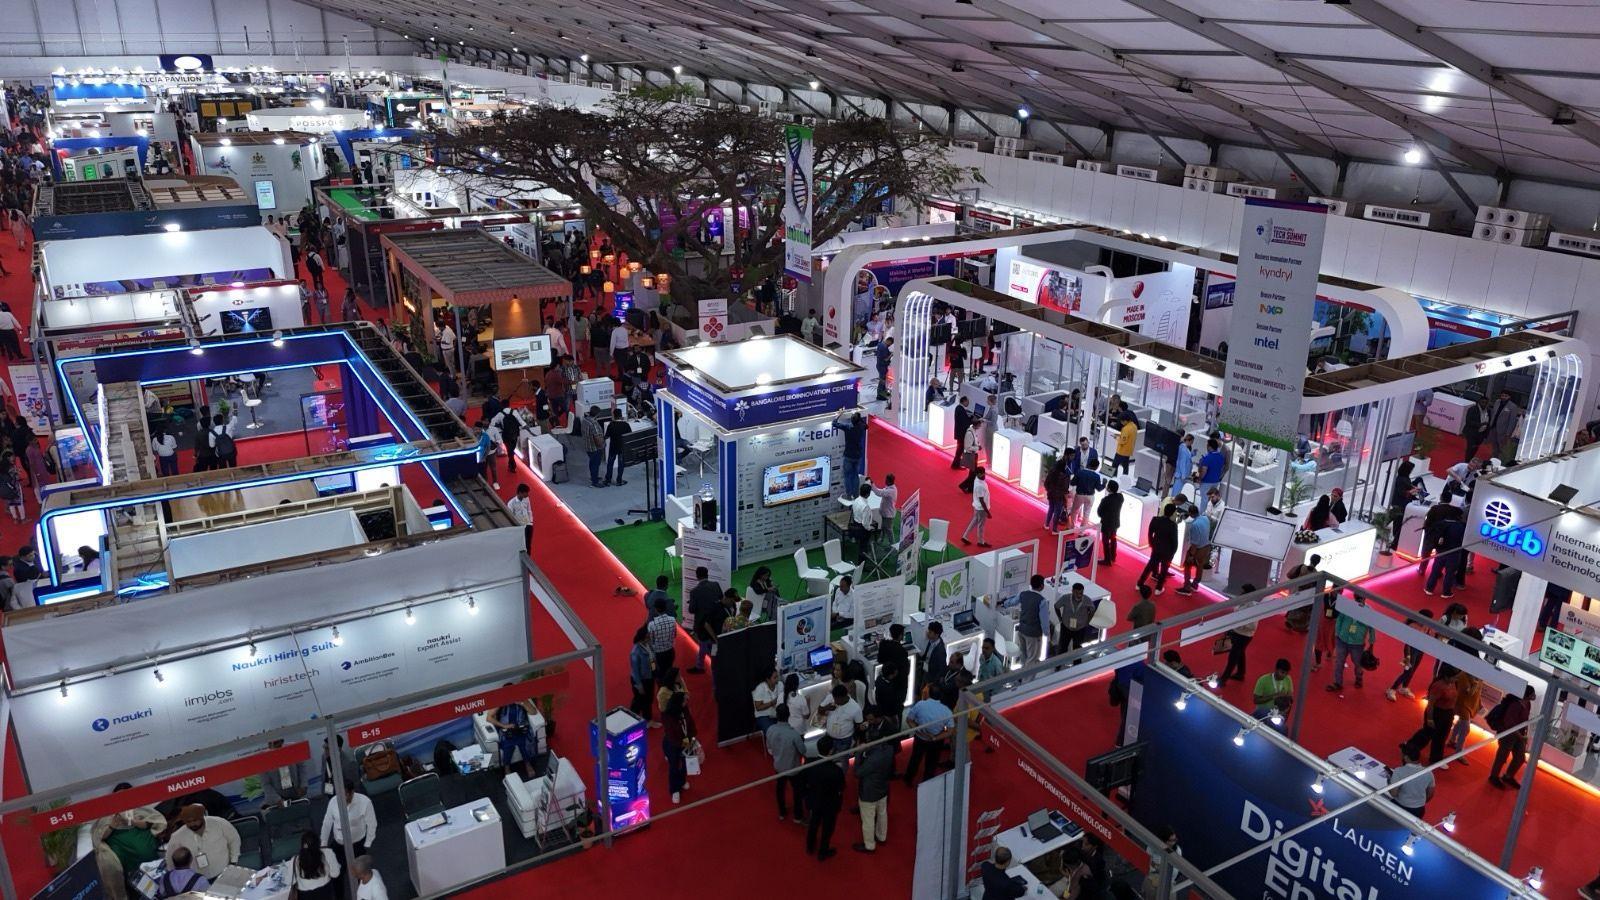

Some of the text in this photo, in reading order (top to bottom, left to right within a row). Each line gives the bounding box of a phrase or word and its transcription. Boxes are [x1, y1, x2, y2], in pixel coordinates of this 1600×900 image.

[1273, 230, 1307, 242] TECH SUMMIT
[1259, 265, 1293, 282] kyndryl
[1126, 304, 1139, 313] MADE
[1259, 303, 1284, 315] NXP
[1123, 312, 1145, 323] MOSCOW
[1253, 336, 1280, 350] intel
[750, 395, 785, 407] BANGALORE
[832, 383, 854, 393] CENTRE
[798, 427, 839, 443] K-tech
[1552, 543, 1595, 565] Institute
[417, 636, 462, 652] Expert Assist
[427, 632, 451, 644] naukri
[232, 654, 273, 672] Naukri
[275, 647, 310, 662] Hiring
[353, 651, 396, 667] AmbitionBox
[263, 668, 320, 689] hirist.tech
[184, 687, 233, 708] iimjobs
[454, 698, 486, 714] NAUKRI
[112, 707, 153, 725] naukri
[361, 727, 381, 740] B-15
[167, 775, 206, 793] NAUKRI
[1017, 758, 1112, 840] LAUREN INFORMATION TECHNOLOGIES
[49, 811, 75, 826] B-15
[1333, 817, 1413, 882] LAUREN
[1380, 865, 1410, 886] GROUP
